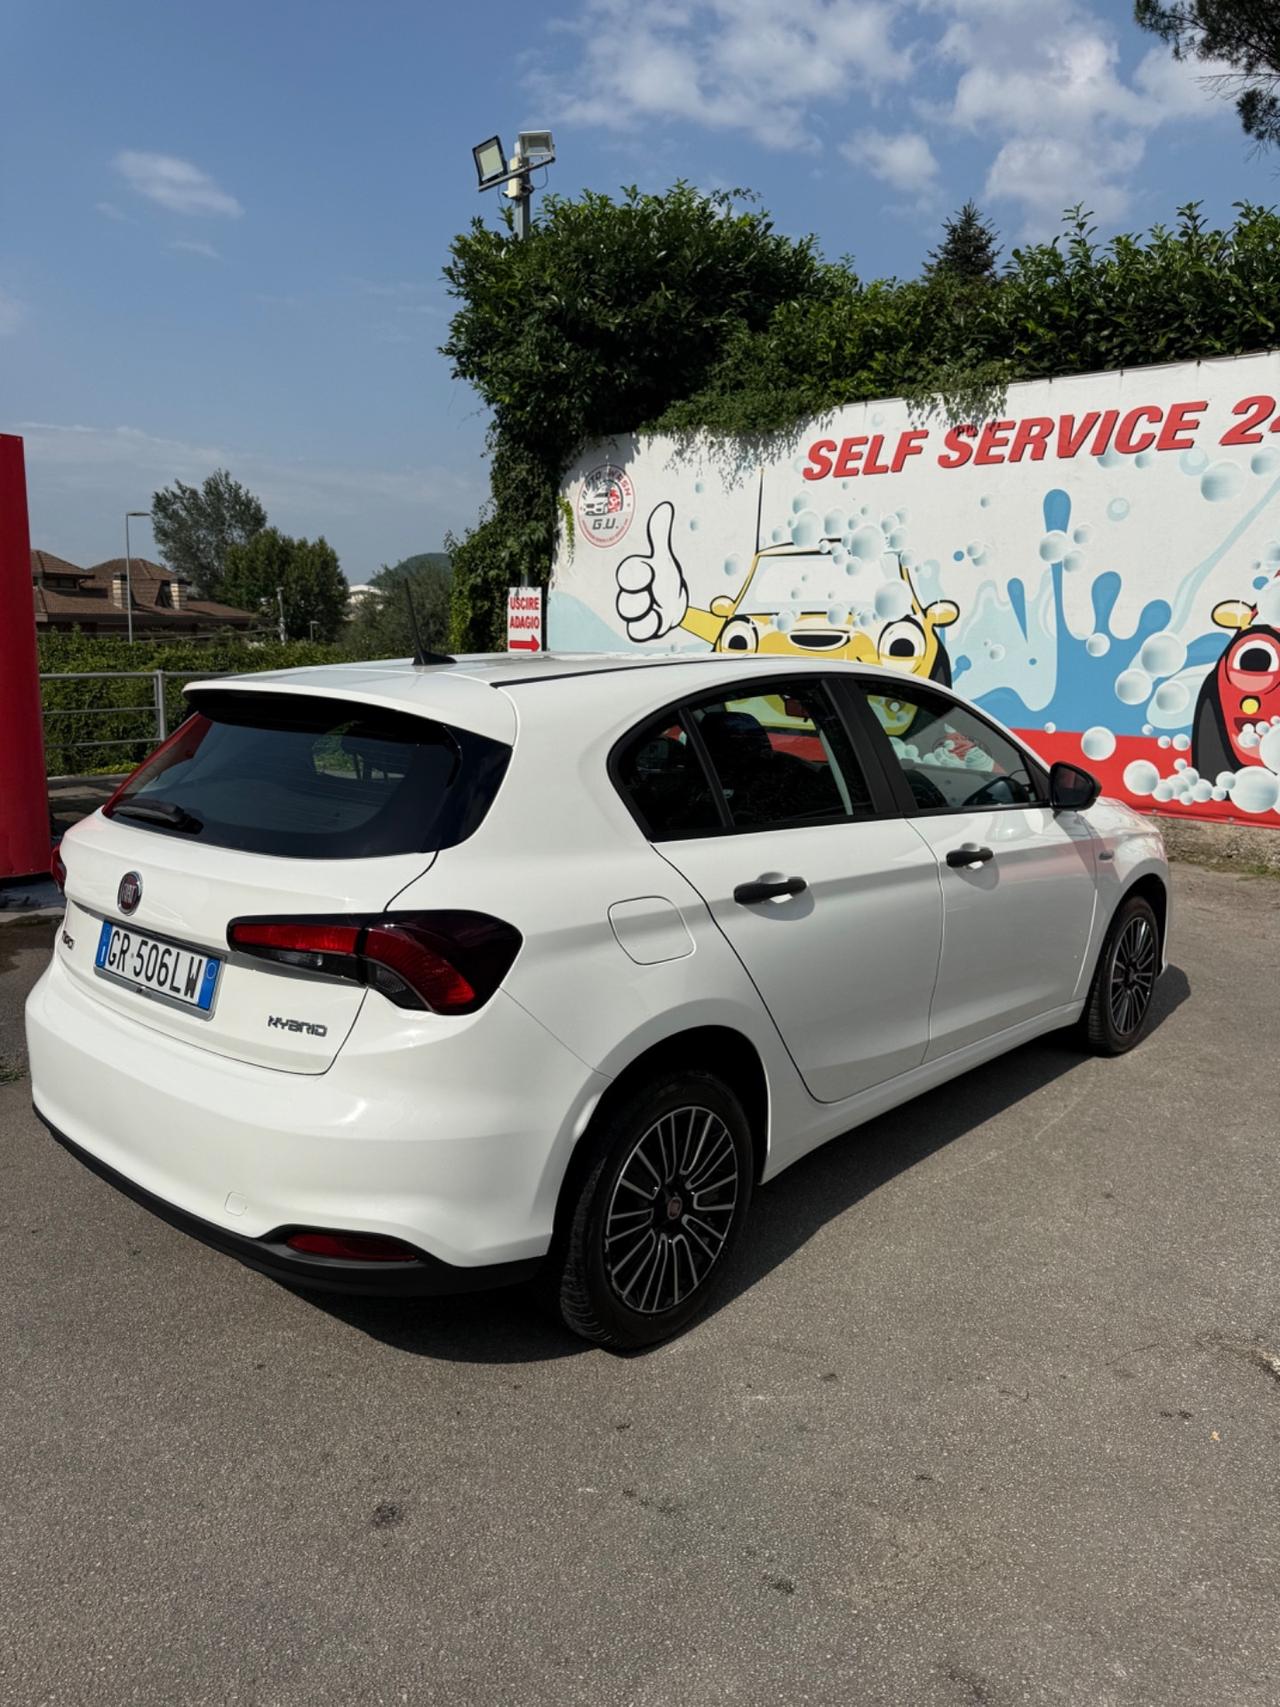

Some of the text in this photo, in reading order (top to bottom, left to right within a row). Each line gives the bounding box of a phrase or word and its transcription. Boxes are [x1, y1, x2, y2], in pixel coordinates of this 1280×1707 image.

[802, 395, 1280, 481] SELF SERVICE 2
[509, 597, 540, 610] USCIRE
[509, 616, 540, 629] ADAGIO
[267, 1015, 328, 1037] HYBRID
